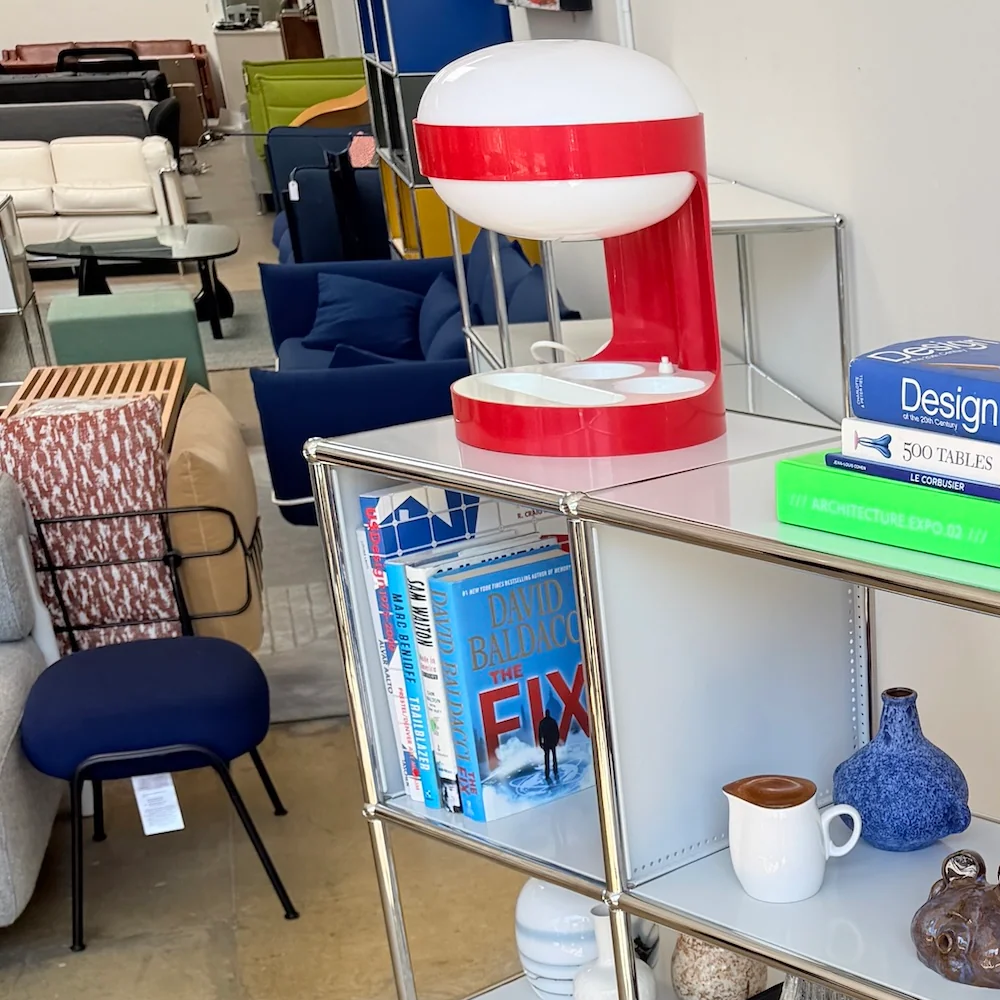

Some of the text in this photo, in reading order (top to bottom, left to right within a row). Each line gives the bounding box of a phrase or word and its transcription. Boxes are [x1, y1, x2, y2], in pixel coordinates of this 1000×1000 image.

[901, 377, 998, 433] Design
[903, 442, 993, 472] 500 TABLES
[910, 473, 965, 492] LE CORBUSIER
[392, 593, 407, 629] MARC
[407, 579, 427, 602] SAM
[469, 587, 480, 596] NEW
[487, 579, 564, 629] DAVID
[412, 606, 433, 648] WALTON
[432, 589, 455, 656] DAVID
[468, 610, 580, 673] BALDACC
[379, 639, 393, 694] ALVAR AALTO
[399, 634, 417, 684] BENIOFF
[489, 663, 523, 685] THE
[409, 696, 430, 771] TRAILBLAZER
[478, 663, 590, 772] FIX
[457, 766, 471, 796] FIX
[468, 771, 478, 795] THE
